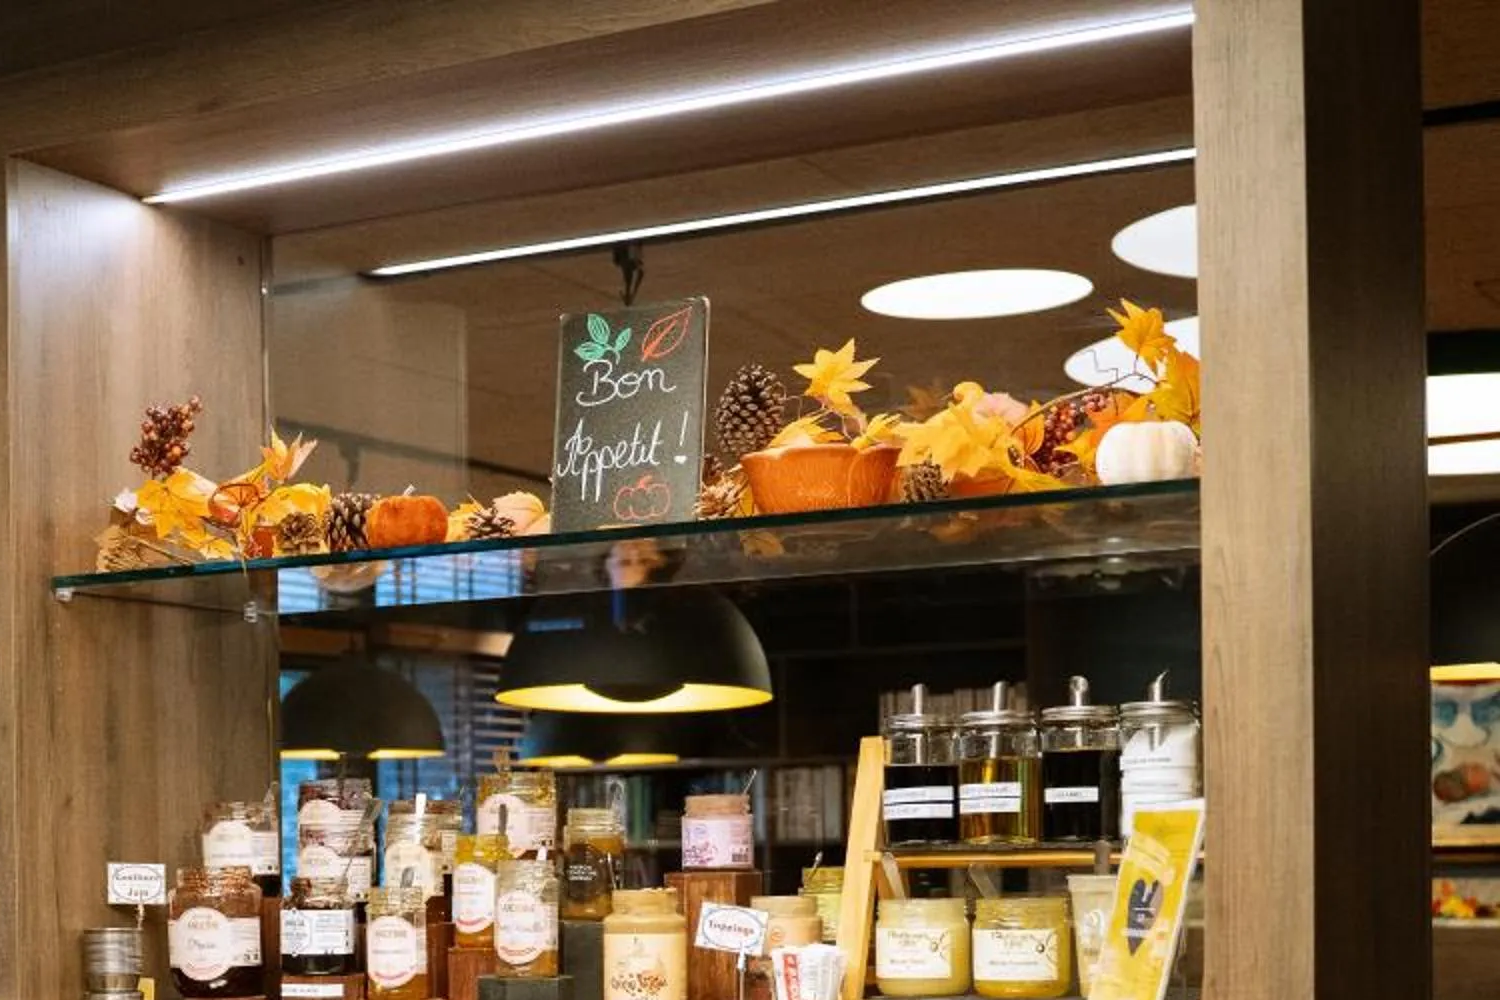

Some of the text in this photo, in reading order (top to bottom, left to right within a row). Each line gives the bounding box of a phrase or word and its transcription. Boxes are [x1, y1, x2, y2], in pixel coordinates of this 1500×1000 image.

[575, 358, 677, 407] Bon
[556, 410, 689, 502] Appetit !
